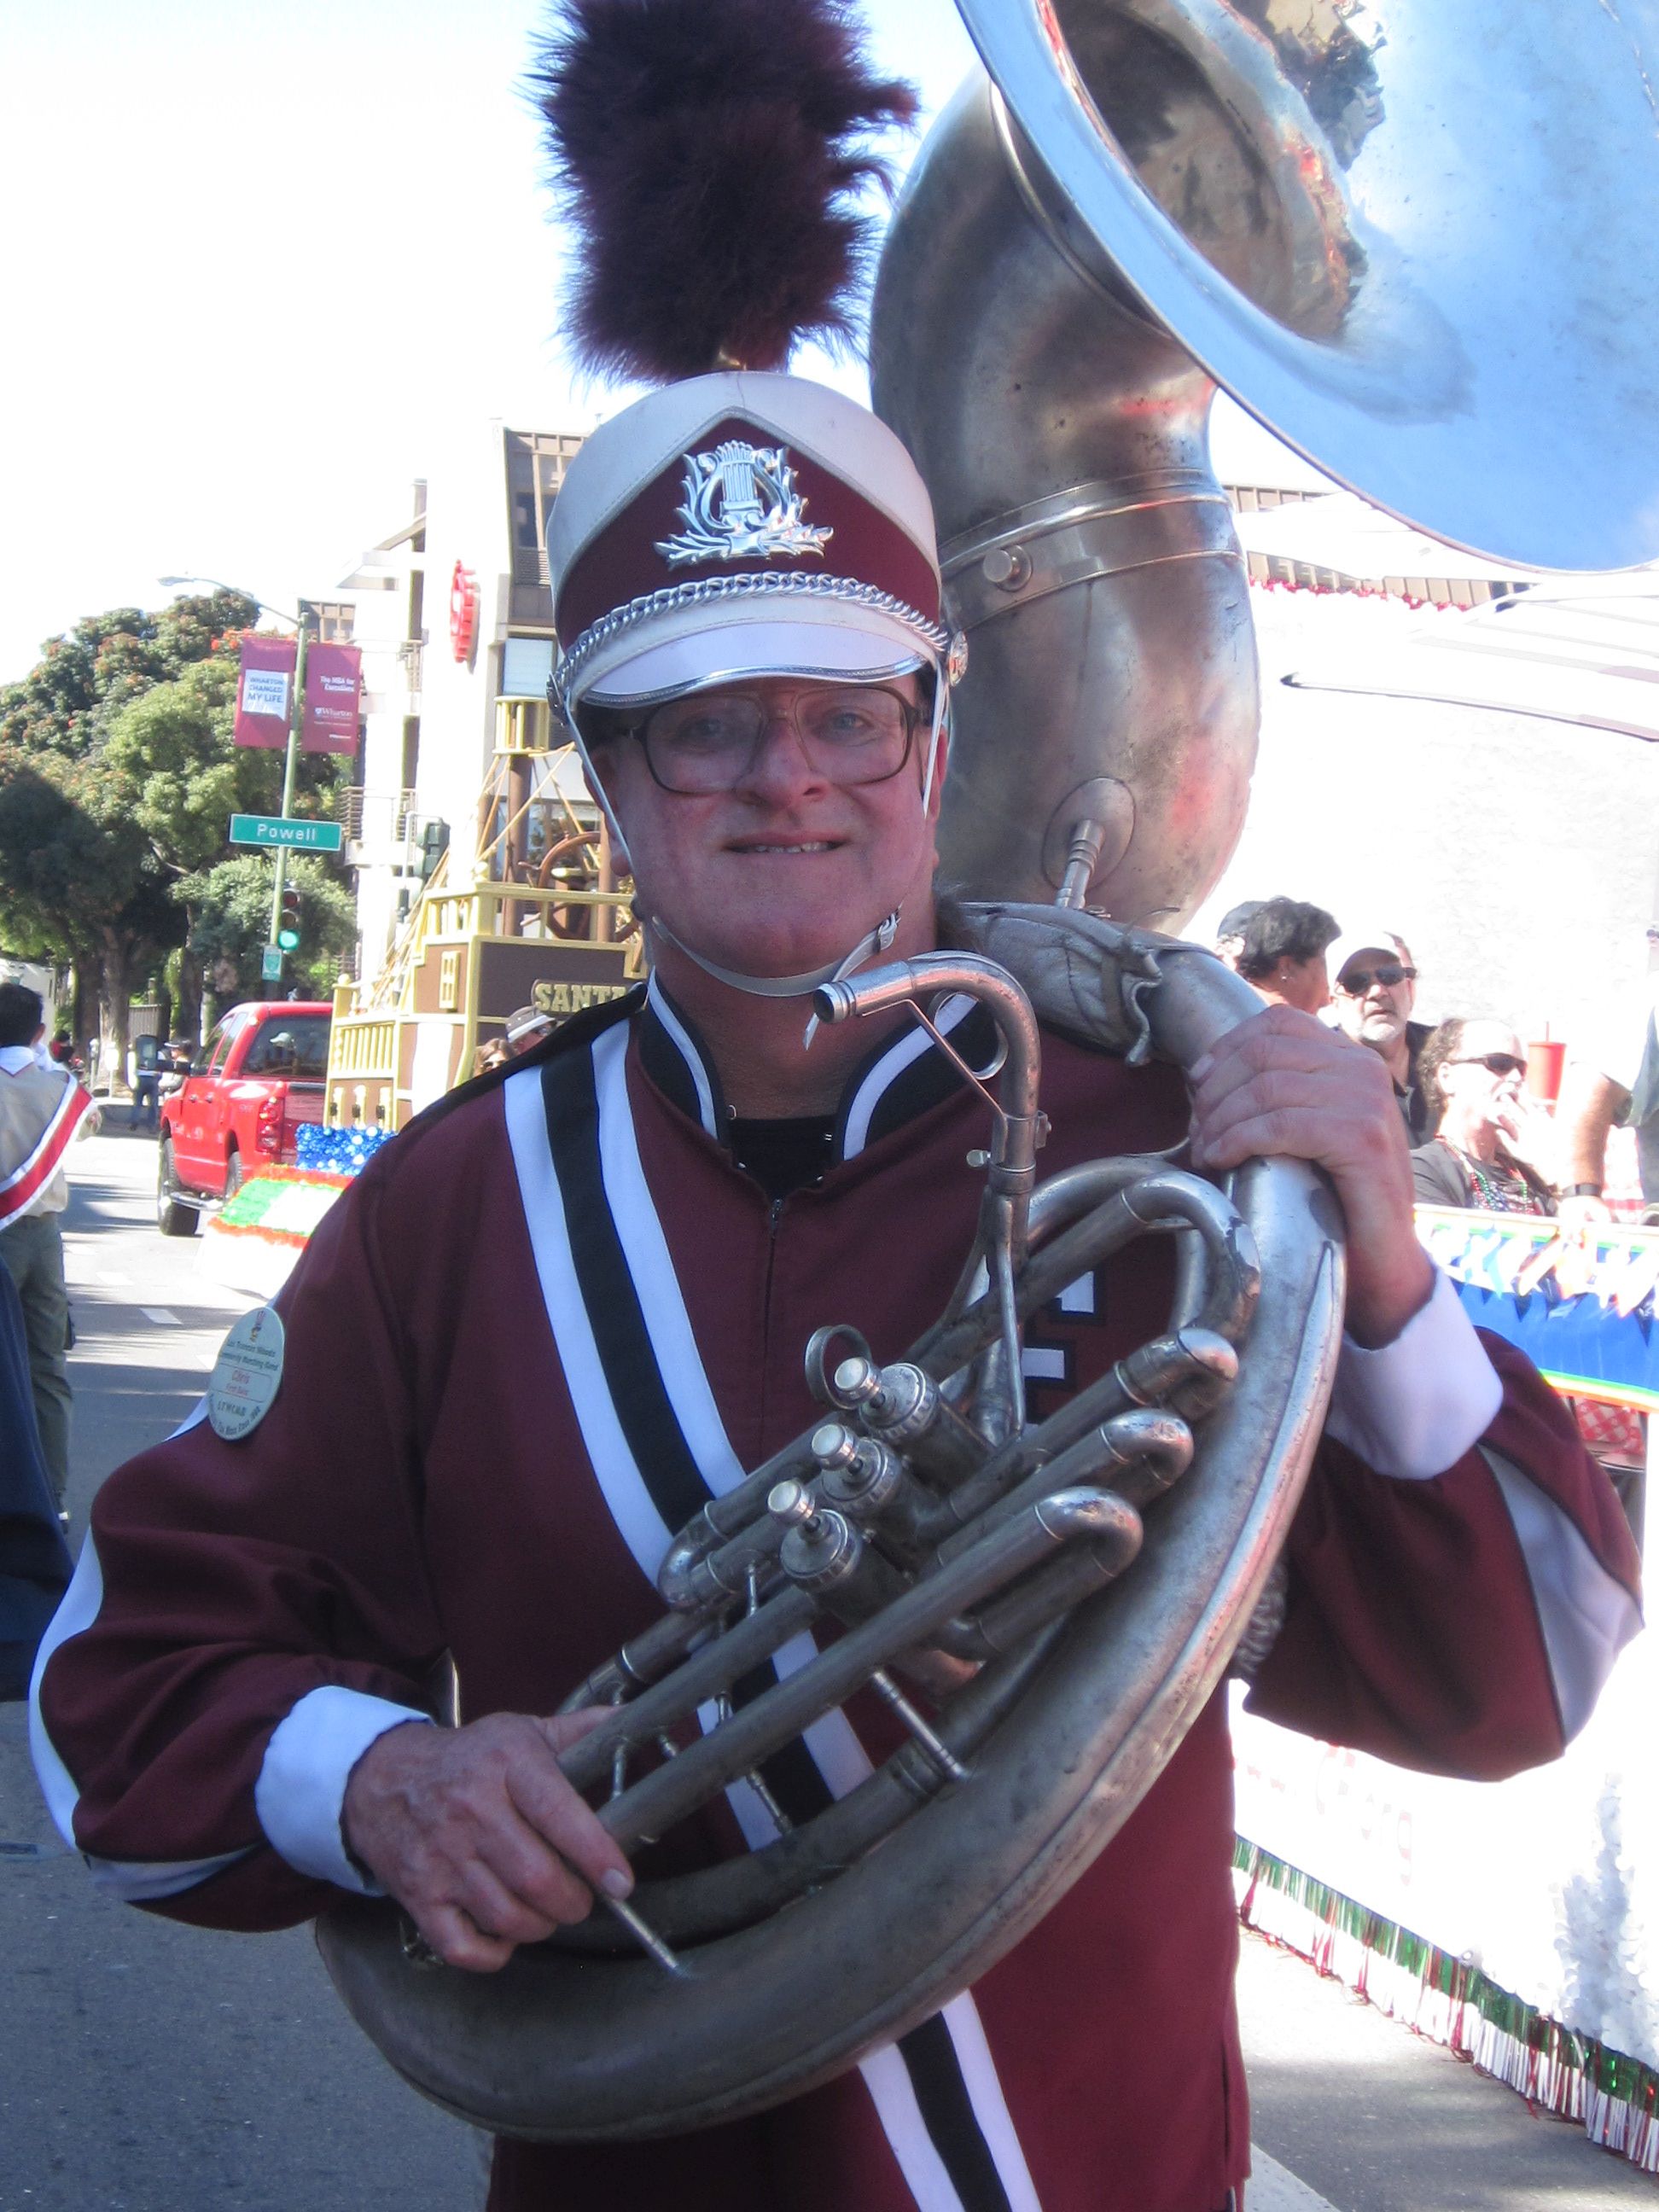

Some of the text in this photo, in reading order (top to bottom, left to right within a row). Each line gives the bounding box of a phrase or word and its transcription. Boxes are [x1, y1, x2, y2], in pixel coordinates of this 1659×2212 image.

[248, 684, 282, 693] CHANGED
[247, 692, 262, 701] MY
[322, 707, 353, 717] Wharton
[257, 823, 316, 841] Powell
